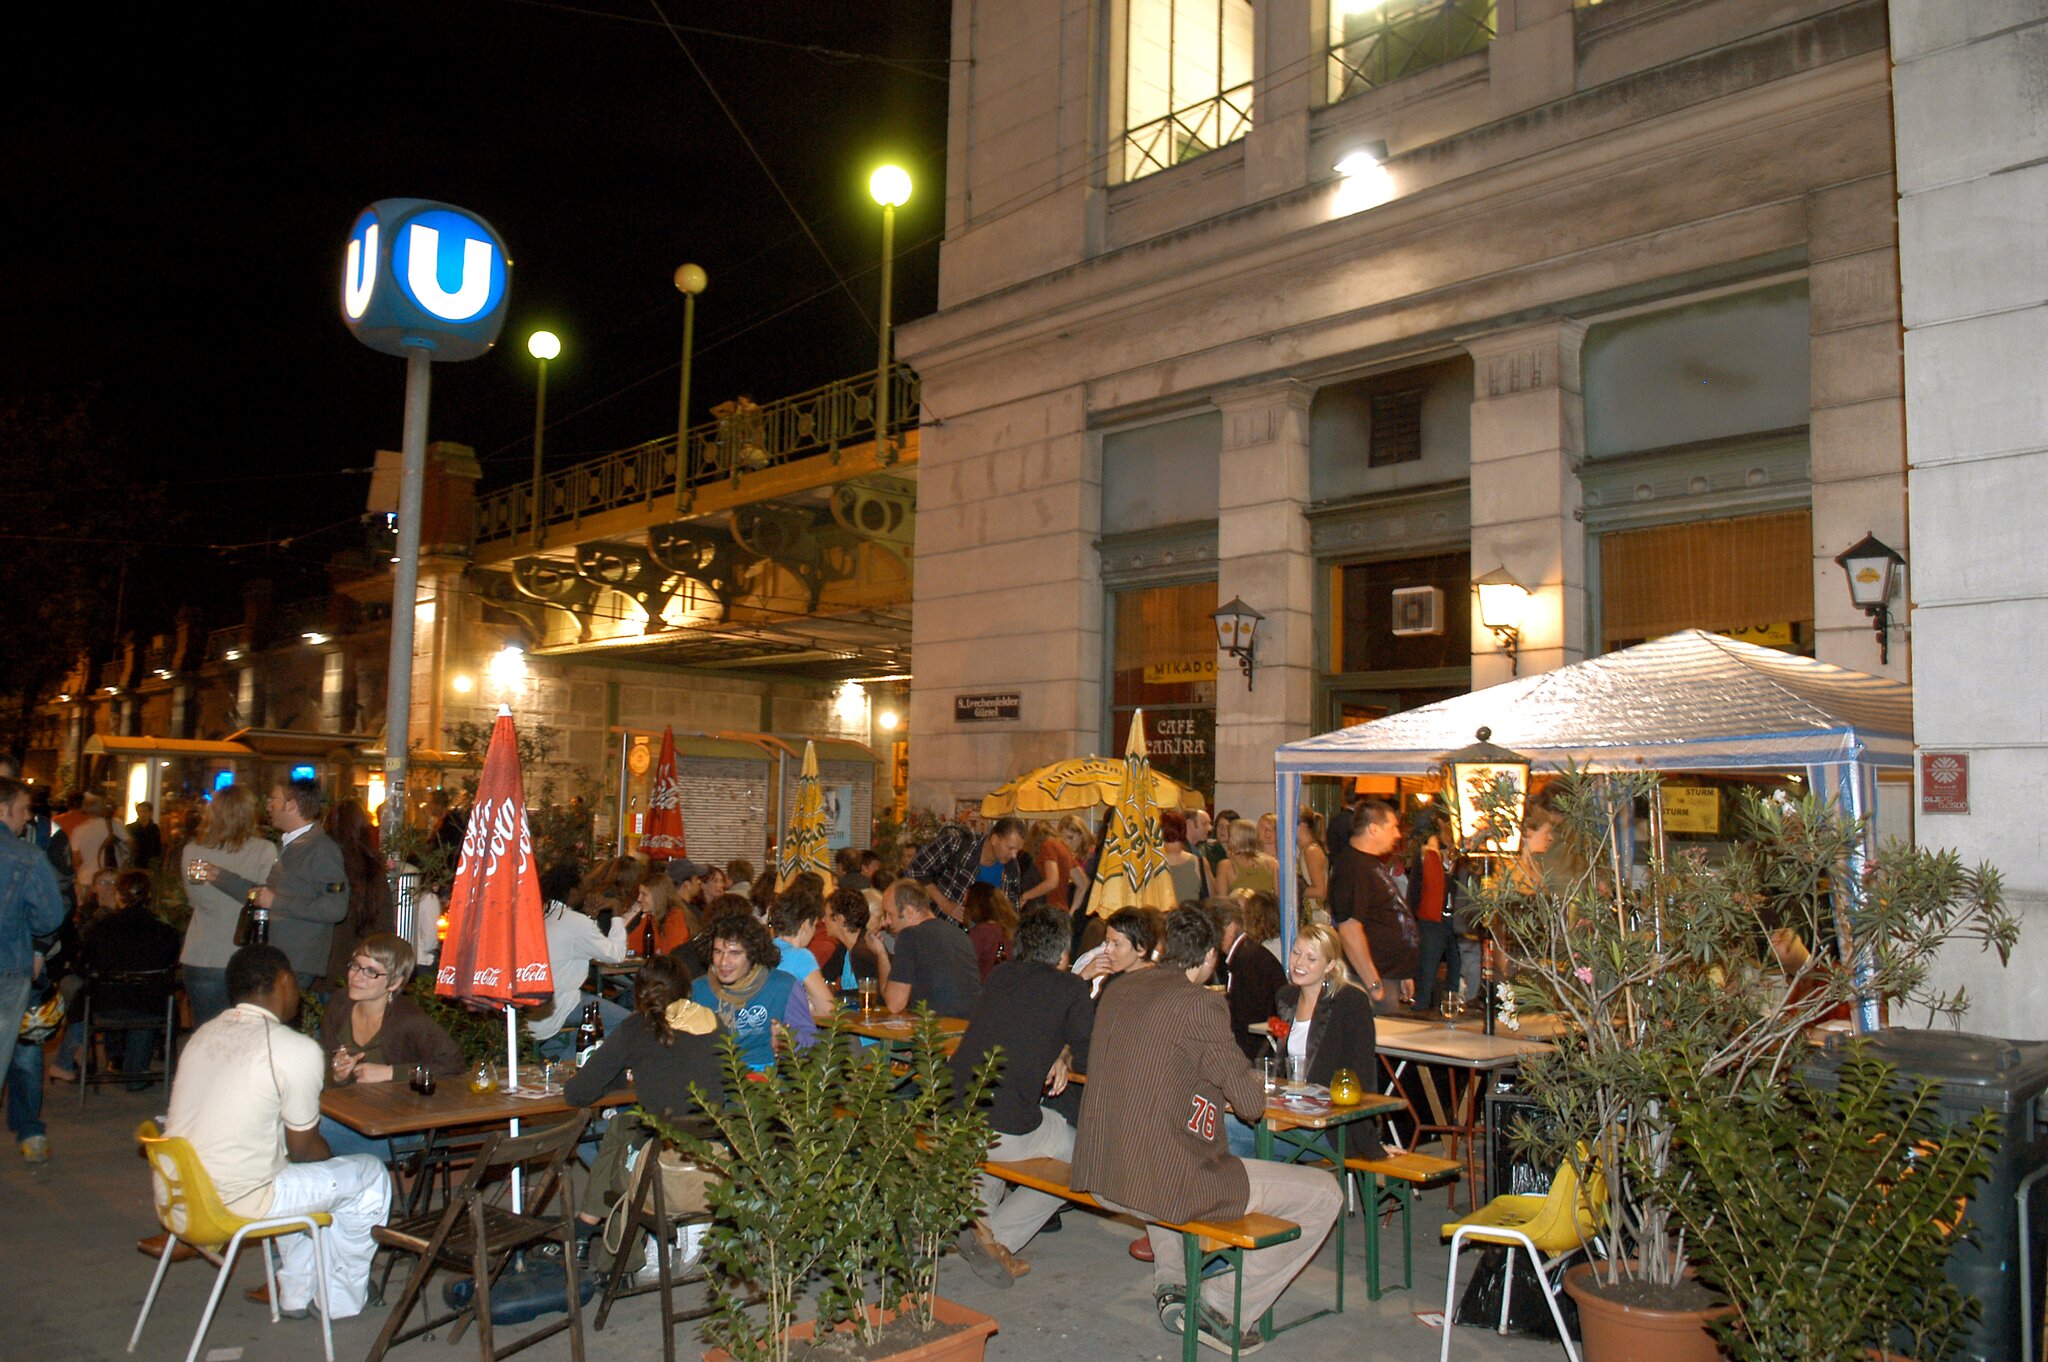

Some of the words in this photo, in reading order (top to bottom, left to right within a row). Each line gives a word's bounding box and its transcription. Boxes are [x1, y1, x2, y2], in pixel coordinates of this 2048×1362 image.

[345, 224, 378, 318] U
[408, 224, 492, 320] U
[1154, 661, 1213, 675] MIKADO
[1157, 719, 1196, 735] CAFE
[1685, 788, 1714, 796] STURM
[1188, 1094, 1217, 1140] 78
